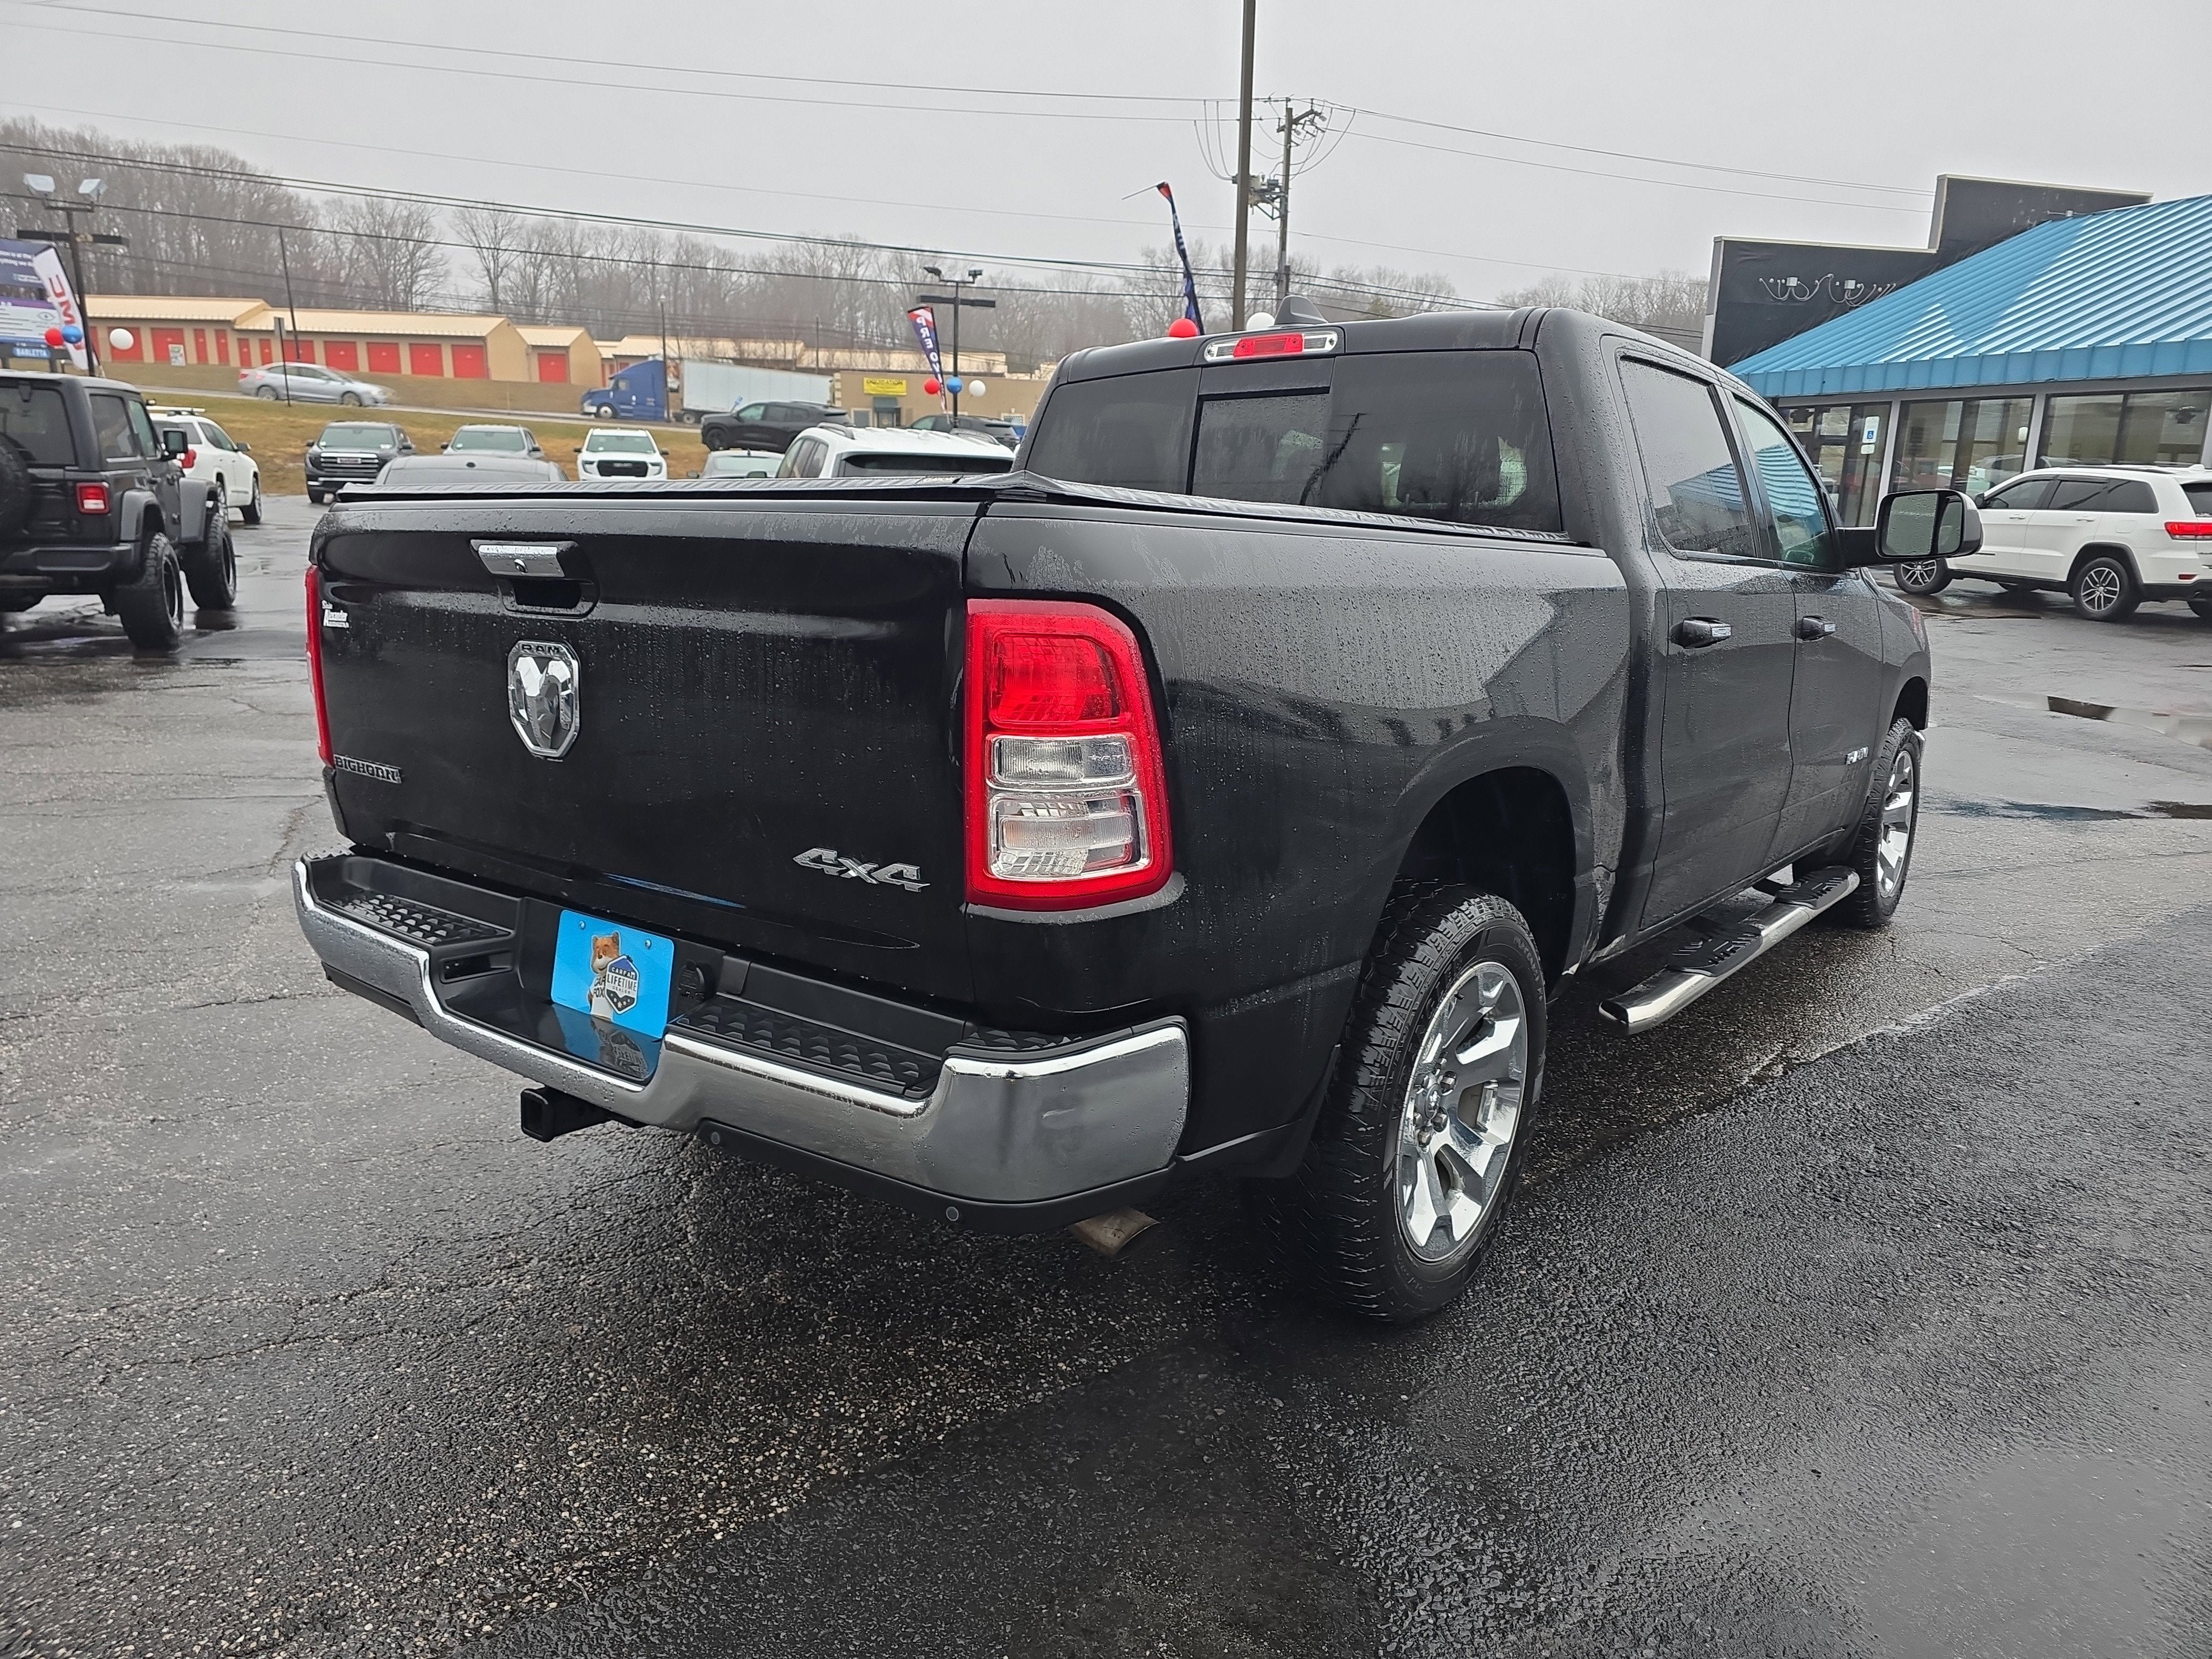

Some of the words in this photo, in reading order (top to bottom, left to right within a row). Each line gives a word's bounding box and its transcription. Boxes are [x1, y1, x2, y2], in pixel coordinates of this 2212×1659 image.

[522, 644, 560, 653] RAM
[335, 756, 398, 782] BIGHORN
[607, 974, 636, 992] LIFETIME
